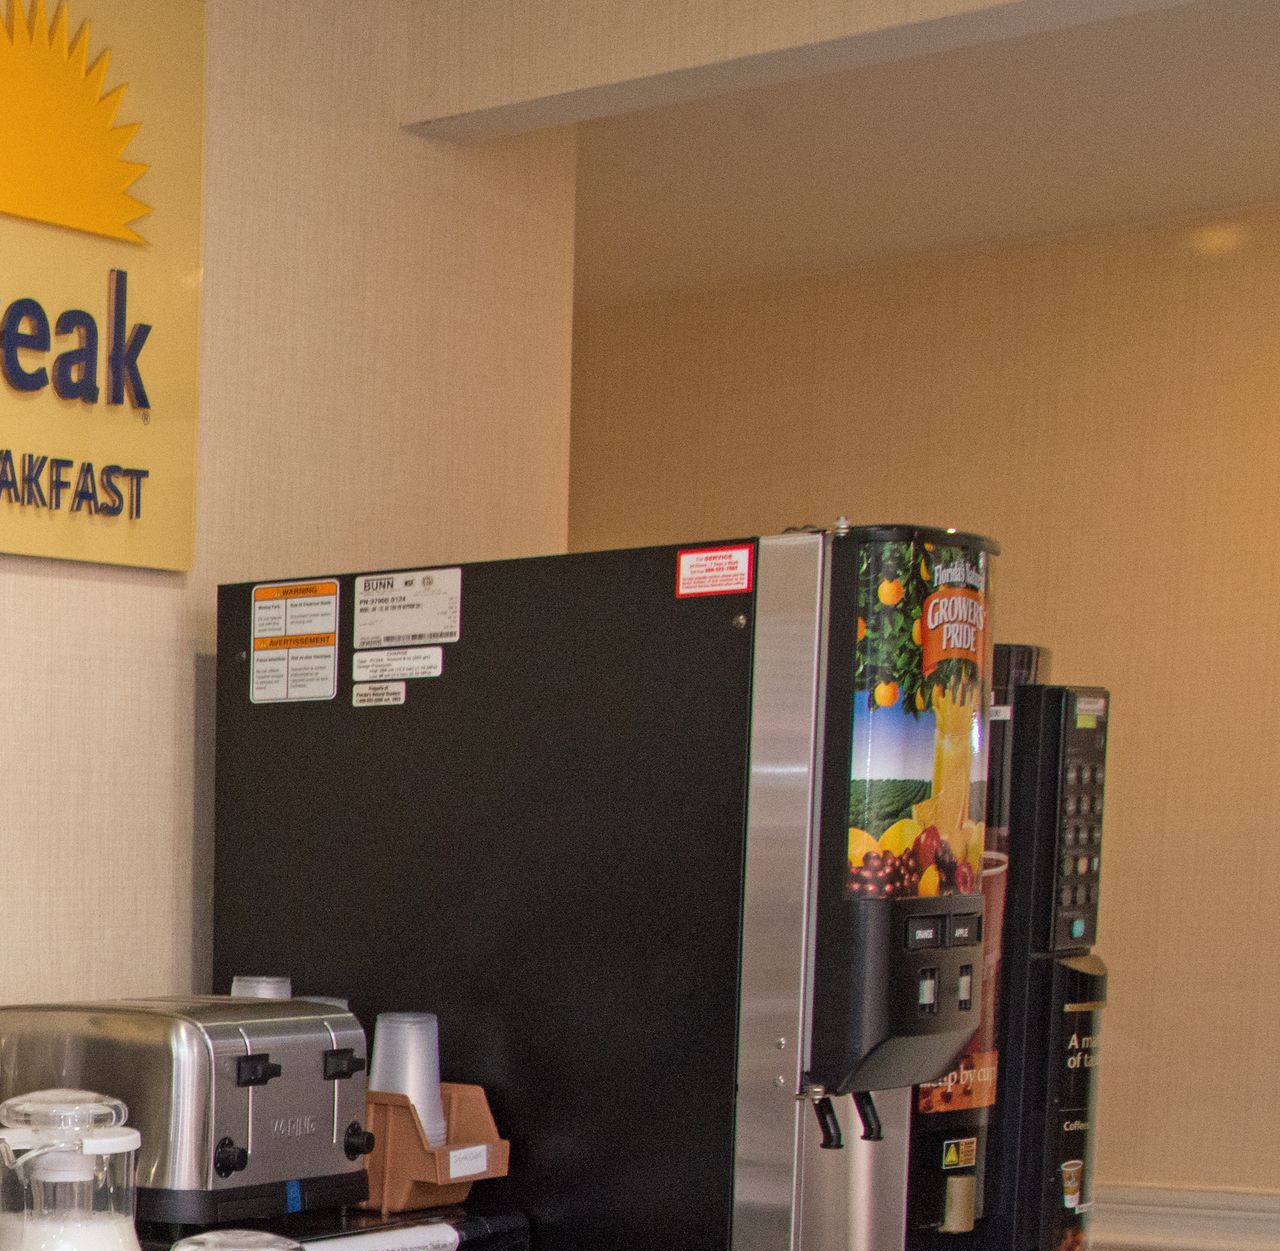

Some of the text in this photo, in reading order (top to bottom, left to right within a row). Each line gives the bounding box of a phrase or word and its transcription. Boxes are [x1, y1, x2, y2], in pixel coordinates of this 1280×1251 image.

[282, 585, 317, 596] WARNING
[363, 580, 394, 592] BUNN
[269, 636, 330, 648] AVERTISSEMENT
[943, 623, 977, 652] PRIDE
[954, 927, 969, 938] APPLE
[1068, 1032, 1080, 1049] A
[1067, 1052, 1082, 1069] of
[960, 1064, 976, 1089] by
